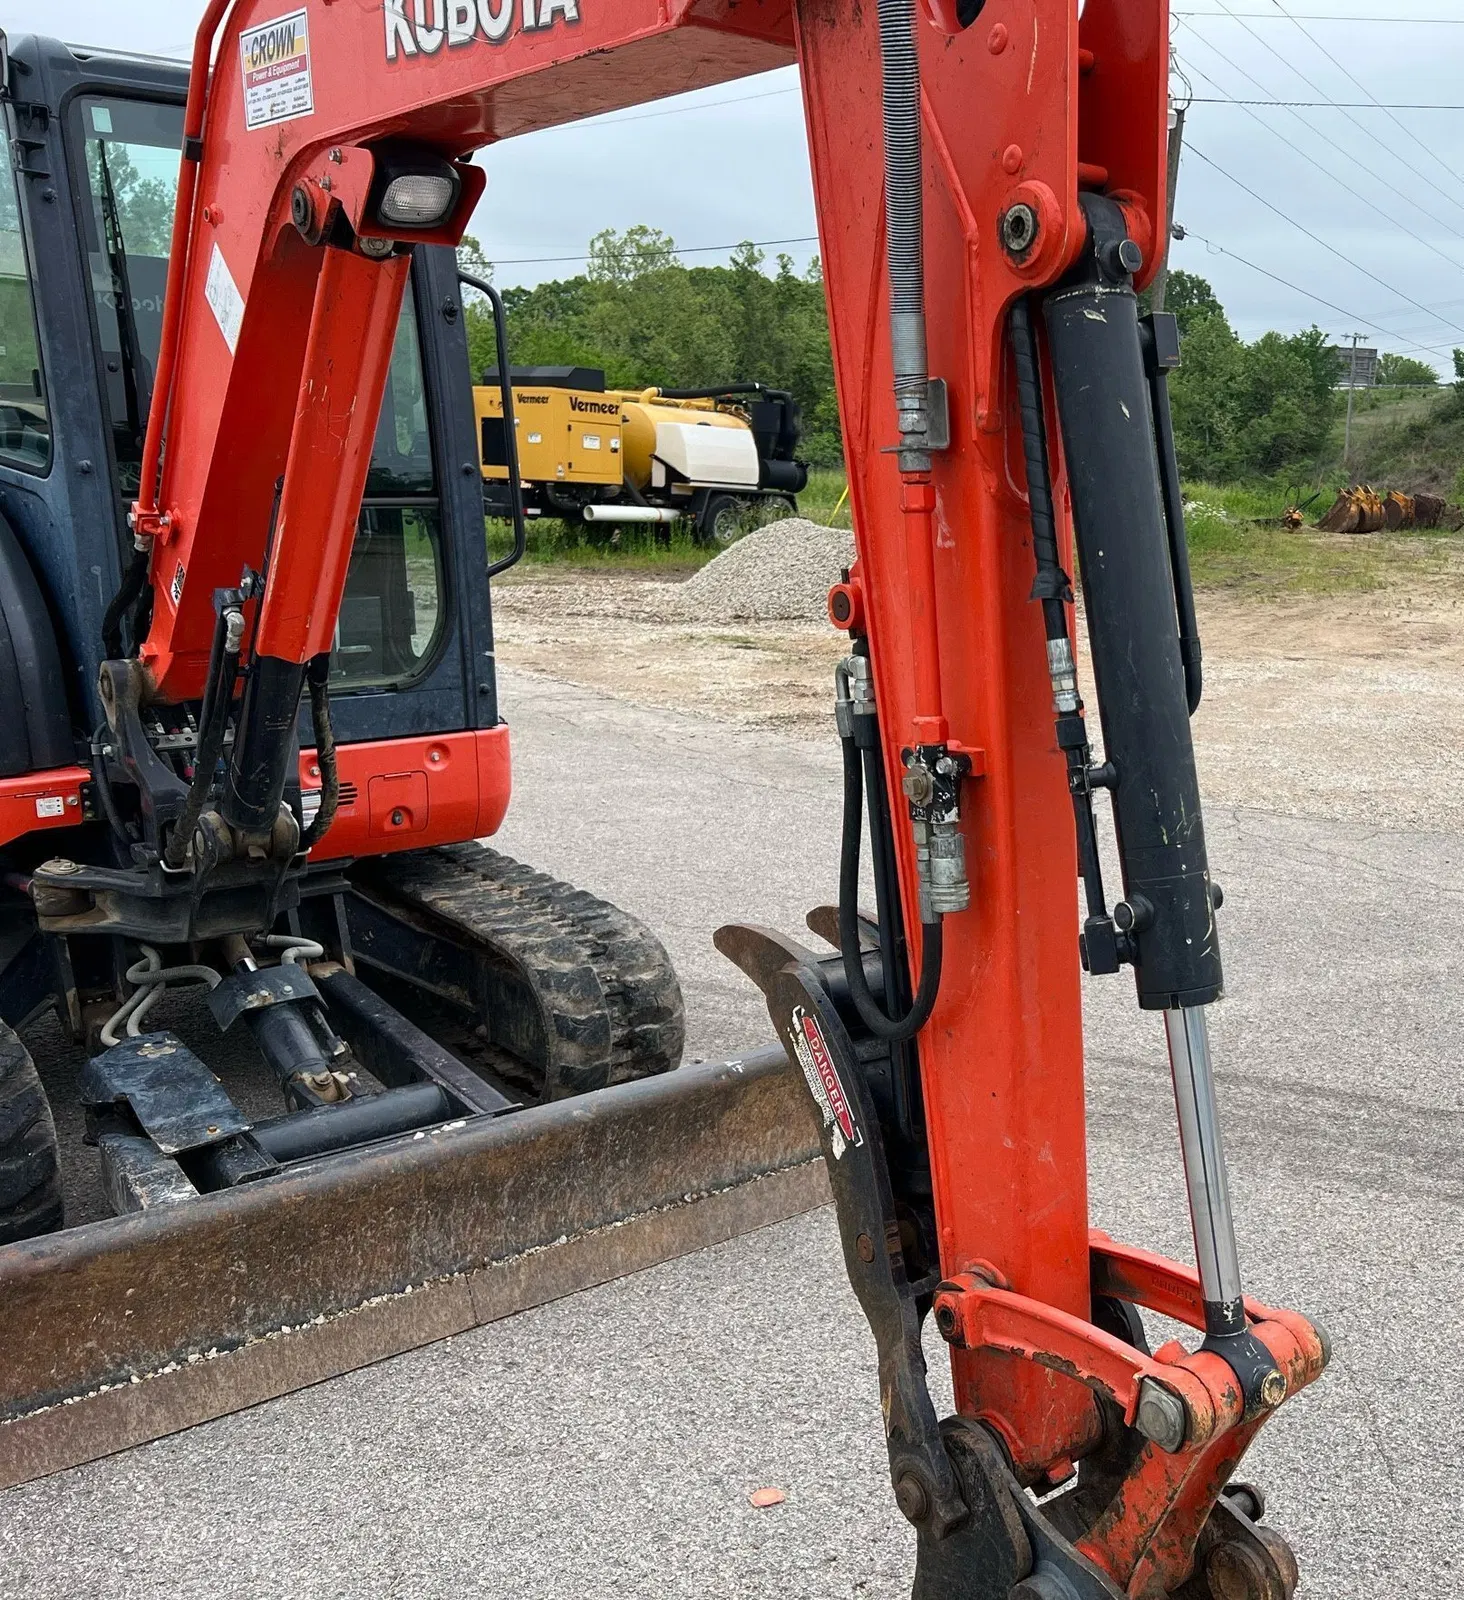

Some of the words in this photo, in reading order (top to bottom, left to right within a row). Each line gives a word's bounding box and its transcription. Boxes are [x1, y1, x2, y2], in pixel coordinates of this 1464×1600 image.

[251, 23, 296, 67] CROWN
[252, 71, 267, 83] Power
[267, 66, 273, 78] &
[273, 59, 300, 76] Equipment
[516, 393, 551, 404] Vermeer
[569, 396, 620, 415] Vermeer
[810, 1036, 844, 1115] DANGER
